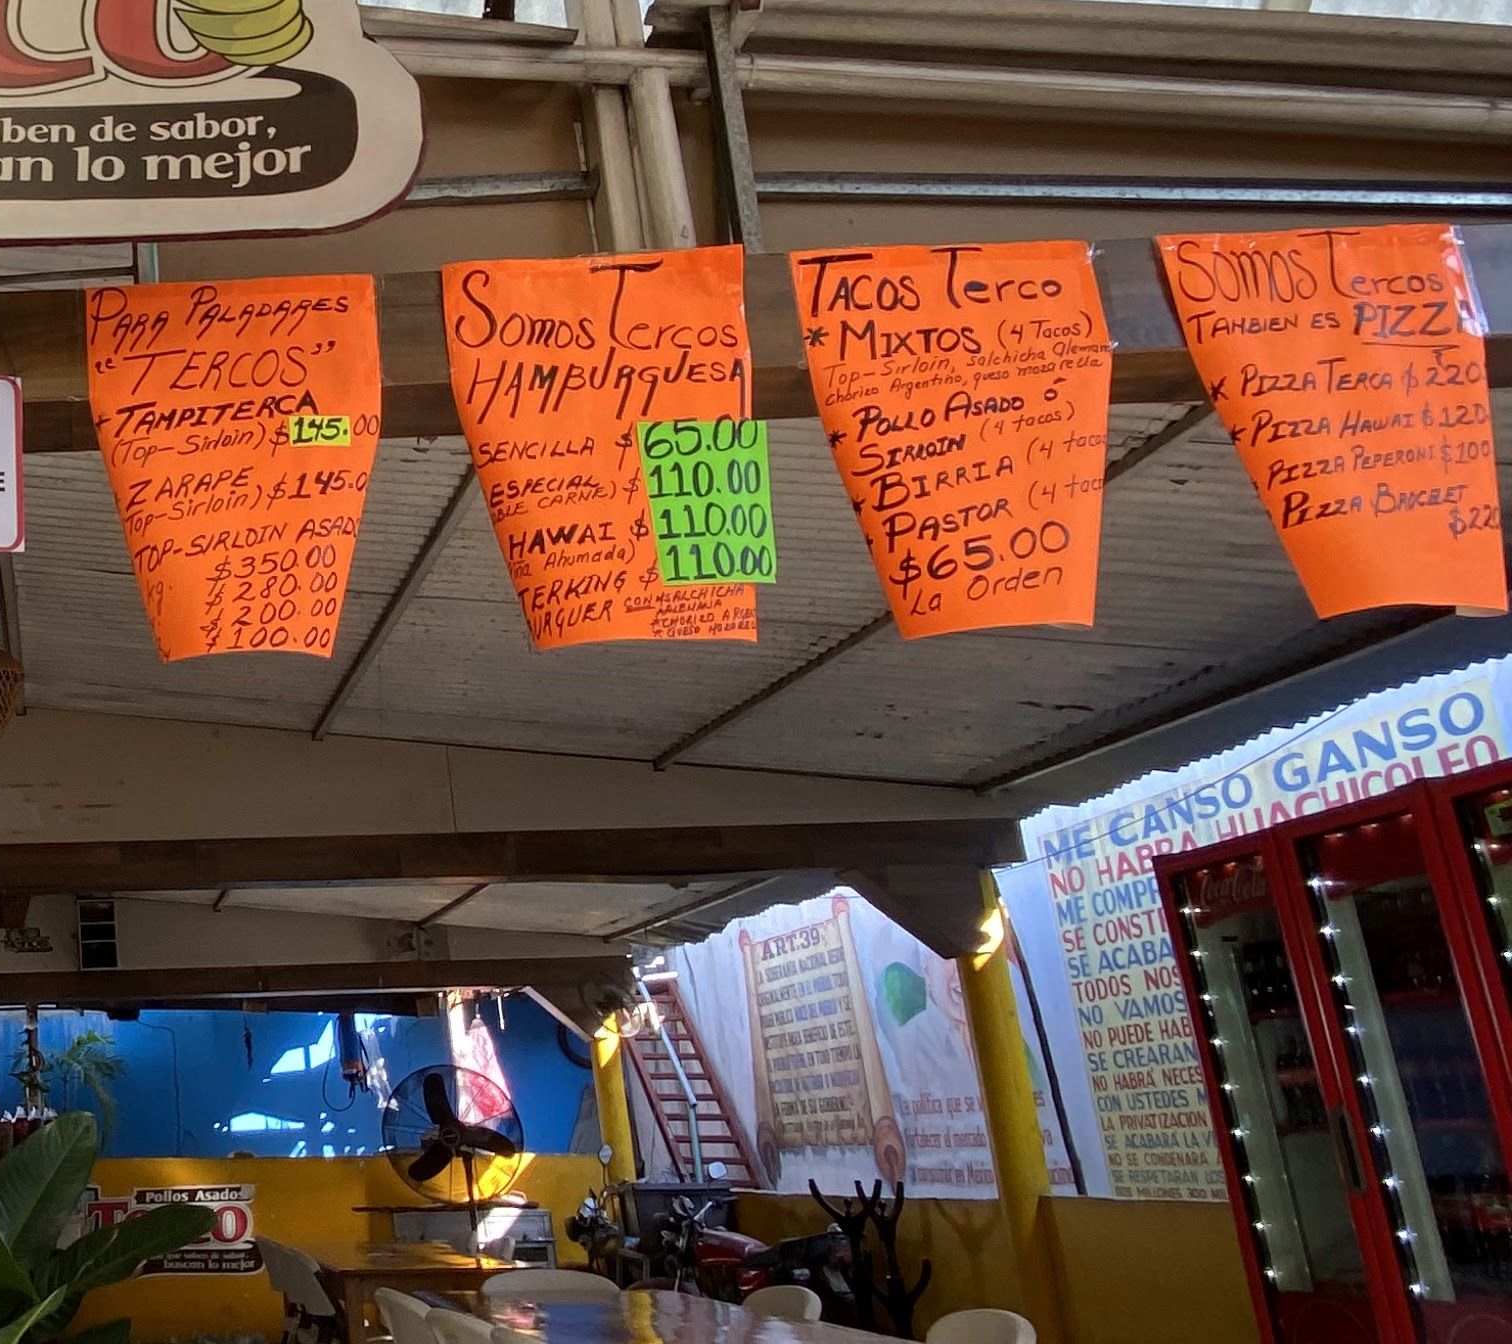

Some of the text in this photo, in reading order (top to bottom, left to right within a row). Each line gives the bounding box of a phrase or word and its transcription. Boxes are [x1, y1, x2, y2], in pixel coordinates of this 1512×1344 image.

[90, 116, 135, 144] de
[150, 113, 276, 142] sabor,
[76, 148, 125, 181] lo
[145, 145, 311, 189] mejor
[798, 247, 1062, 317] TACOS Terco
[91, 285, 349, 354] PARA PALADARES
[456, 259, 738, 350] Somos Tercos
[1311, 312, 1340, 330] ES
[840, 319, 981, 361] MIXTOS
[1241, 363, 1316, 397] PIZZA
[852, 404, 935, 442] POLLO
[1251, 410, 1330, 447] PIZZA
[476, 437, 595, 468] SENCILLA
[126, 466, 254, 512] ZARAPE
[489, 475, 600, 507] ESPECIAL
[870, 456, 1013, 512] BIRRIA
[1268, 459, 1344, 490] PIZZA
[882, 498, 1013, 553] PASTOR
[1282, 490, 1362, 529] PIZZA
[509, 522, 616, 560] HAWAI
[889, 520, 1070, 600] $65.00
[967, 567, 1063, 601] Orden
[1043, 692, 1484, 864] ME CANSO GANSO
[1050, 866, 1085, 899] NO
[1057, 895, 1086, 927] ME
[1063, 927, 1086, 953] SE
[1069, 956, 1091, 979] SE
[1072, 974, 1132, 1003] TODOS
[1079, 990, 1187, 1028] NO VAMOS
[1082, 1029, 1102, 1049] NO
[1108, 1022, 1154, 1047] PUEDE
[1089, 1042, 1198, 1073] SE CREARAN
[1092, 1075, 1108, 1093] NO
[1097, 1089, 1188, 1112] CON USTEDES
[1101, 1116, 1115, 1132] LA
[1185, 1132, 1200, 1148] LA
[146, 1192, 188, 1202] Pollos
